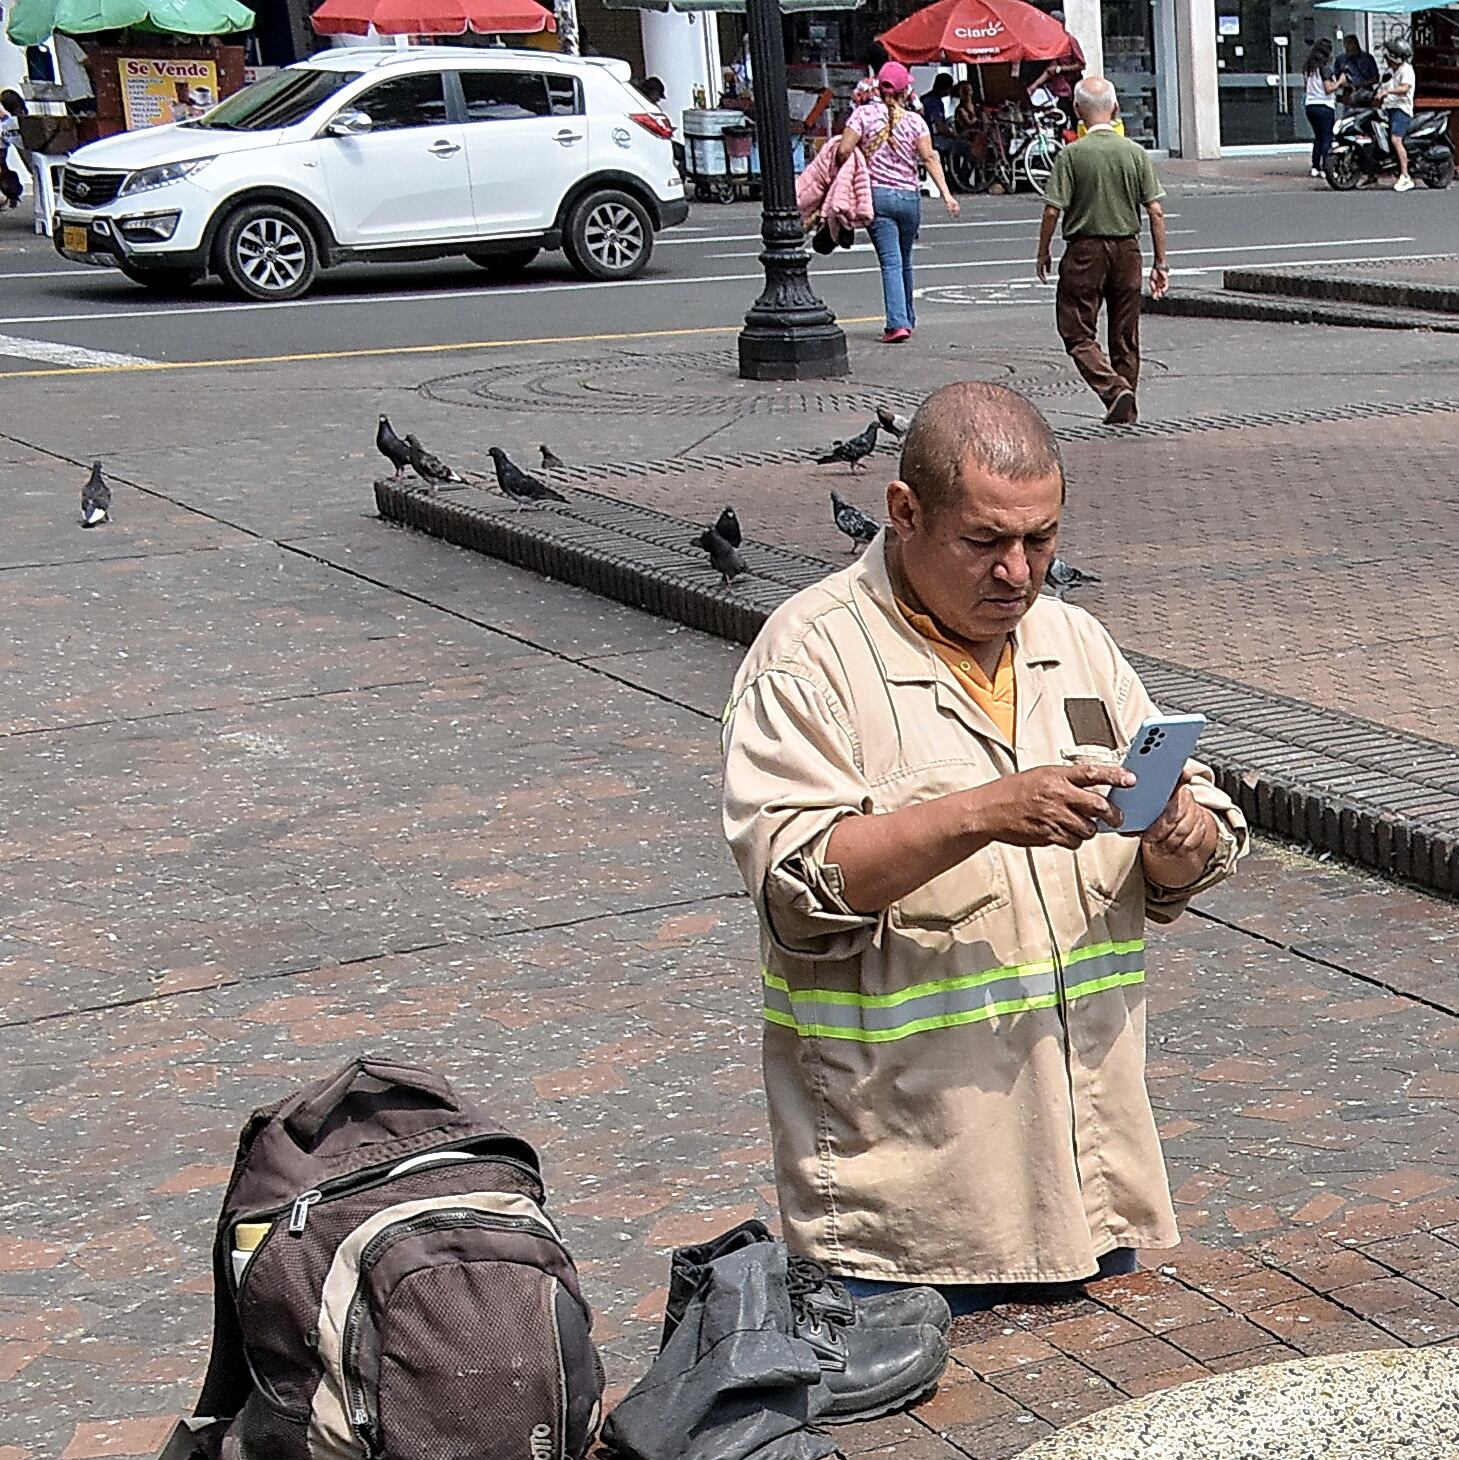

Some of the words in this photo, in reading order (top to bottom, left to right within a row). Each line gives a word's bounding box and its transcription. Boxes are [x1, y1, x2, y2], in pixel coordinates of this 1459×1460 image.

[955, 25, 1000, 38] Claro
[127, 61, 149, 75] Se
[152, 62, 209, 77] Vende
